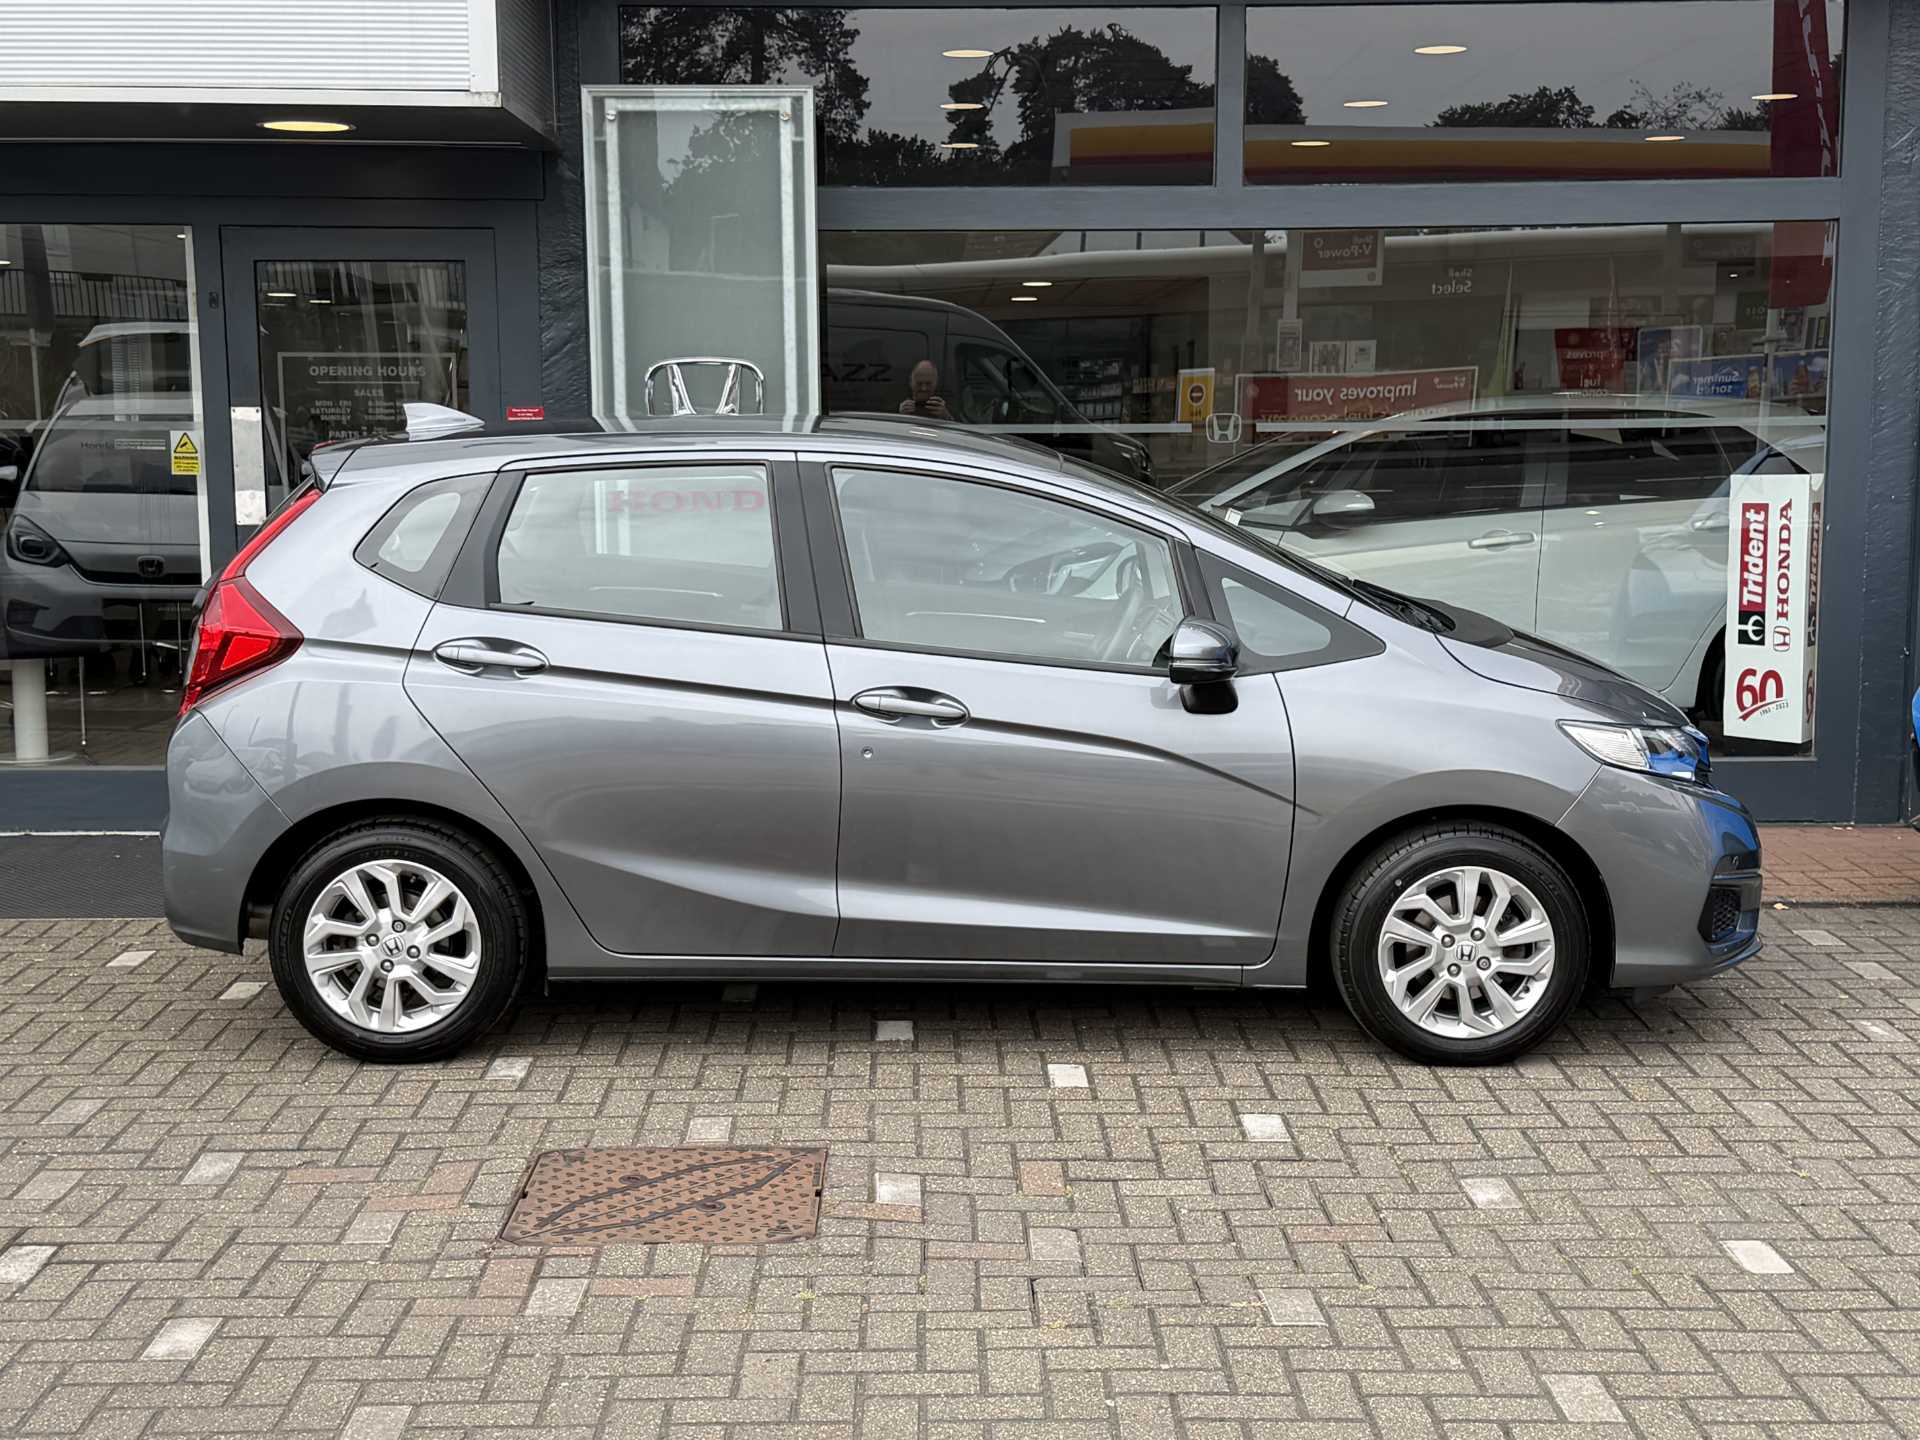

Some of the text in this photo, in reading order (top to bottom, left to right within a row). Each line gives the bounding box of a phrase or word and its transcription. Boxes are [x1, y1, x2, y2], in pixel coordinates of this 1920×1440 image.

[310, 365, 427, 377] OPENING HOURS
[607, 490, 766, 513] HOND
[1742, 508, 1767, 607] Trident
[1776, 498, 1793, 621] HONDA
